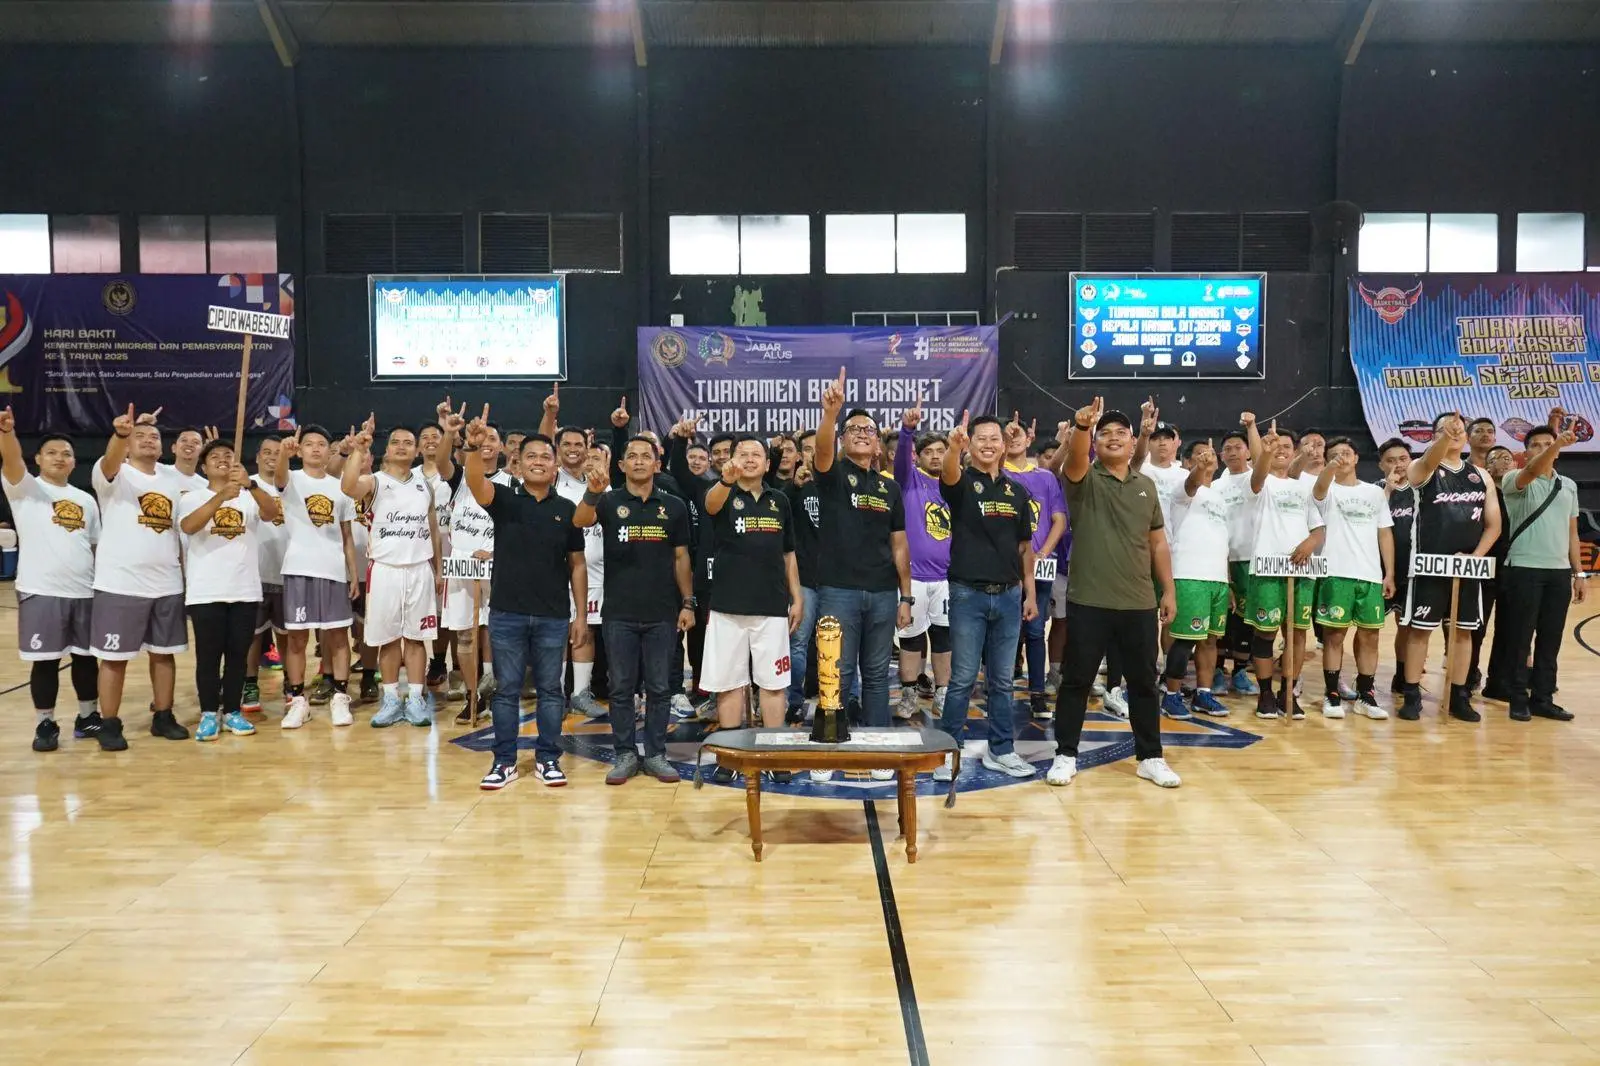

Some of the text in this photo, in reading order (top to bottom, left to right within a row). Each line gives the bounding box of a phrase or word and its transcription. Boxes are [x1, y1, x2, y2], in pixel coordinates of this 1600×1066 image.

[1373, 299, 1409, 307] BASKETBALL
[44, 329, 116, 338] HARI BAKTI
[1459, 317, 1583, 338] TURNAMEN
[745, 336, 781, 351] JABAR
[1461, 337, 1585, 354] BOLA BASKET
[763, 351, 793, 359] ALUS
[1500, 352, 1552, 365] ANTAR
[1384, 367, 1472, 388] KORWIL
[694, 379, 943, 403] TURNAMEN BA BASKET
[1507, 383, 1560, 399] 2025
[442, 560, 485, 577] BANDUNG
[1036, 560, 1054, 578] AYA
[1415, 555, 1490, 577] SUCI RAYA
[1414, 605, 1431, 619] 24
[420, 614, 436, 630] 28
[30, 633, 43, 650] 6
[104, 632, 120, 650] 28
[774, 655, 790, 676] 38
